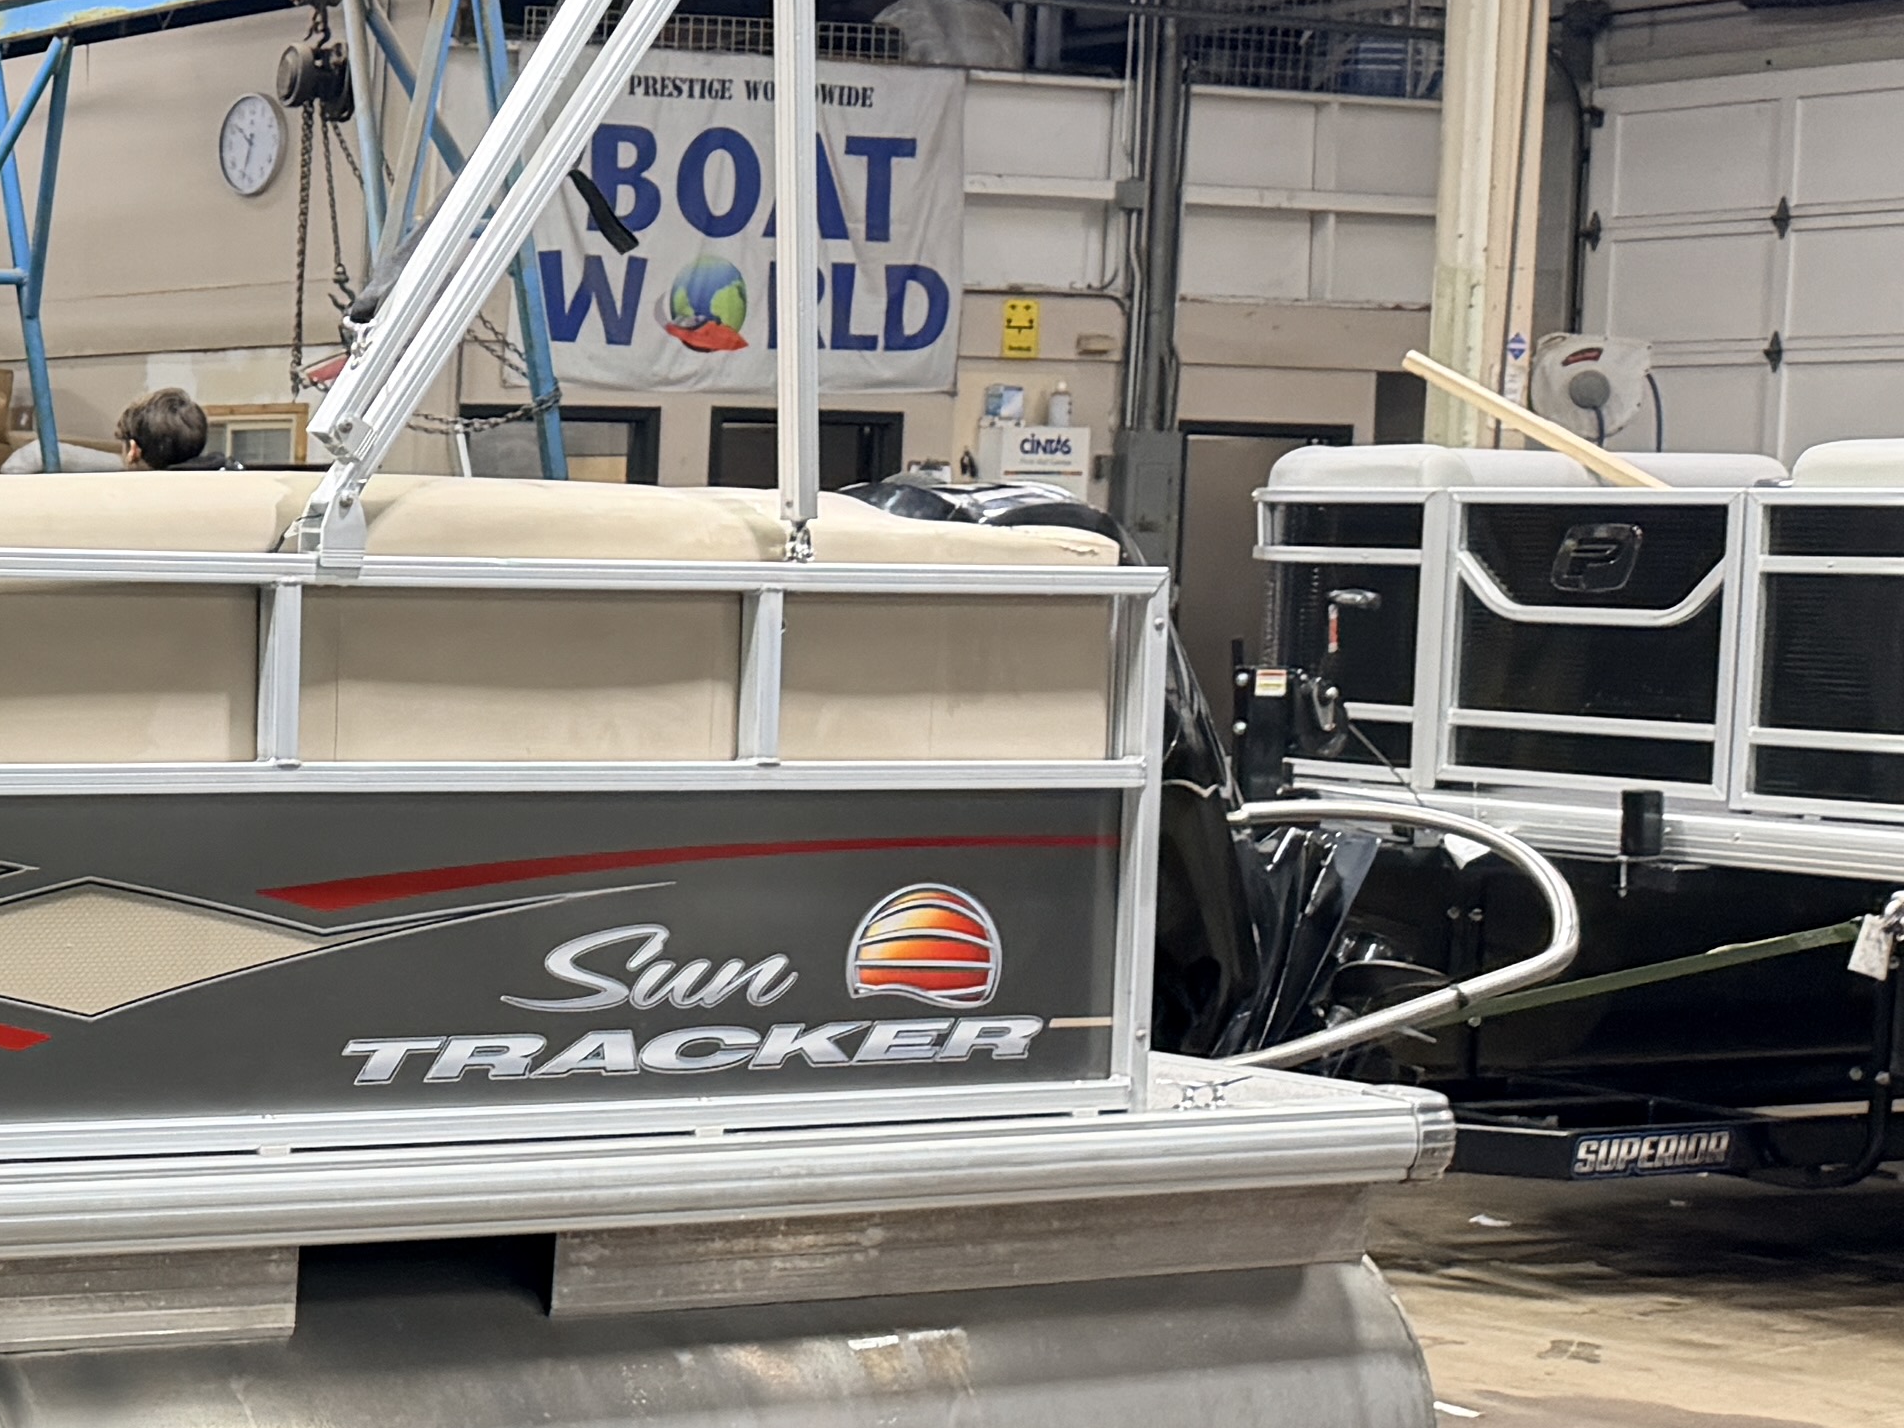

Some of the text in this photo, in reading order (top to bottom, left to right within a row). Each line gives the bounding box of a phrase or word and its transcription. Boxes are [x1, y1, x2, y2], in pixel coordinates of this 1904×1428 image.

[628, 74, 733, 101] PRESTIGE
[500, 922, 799, 1013] Sun
[341, 1014, 1044, 1086] TRACKER
[1573, 1130, 1730, 1173] SUPERIOR
